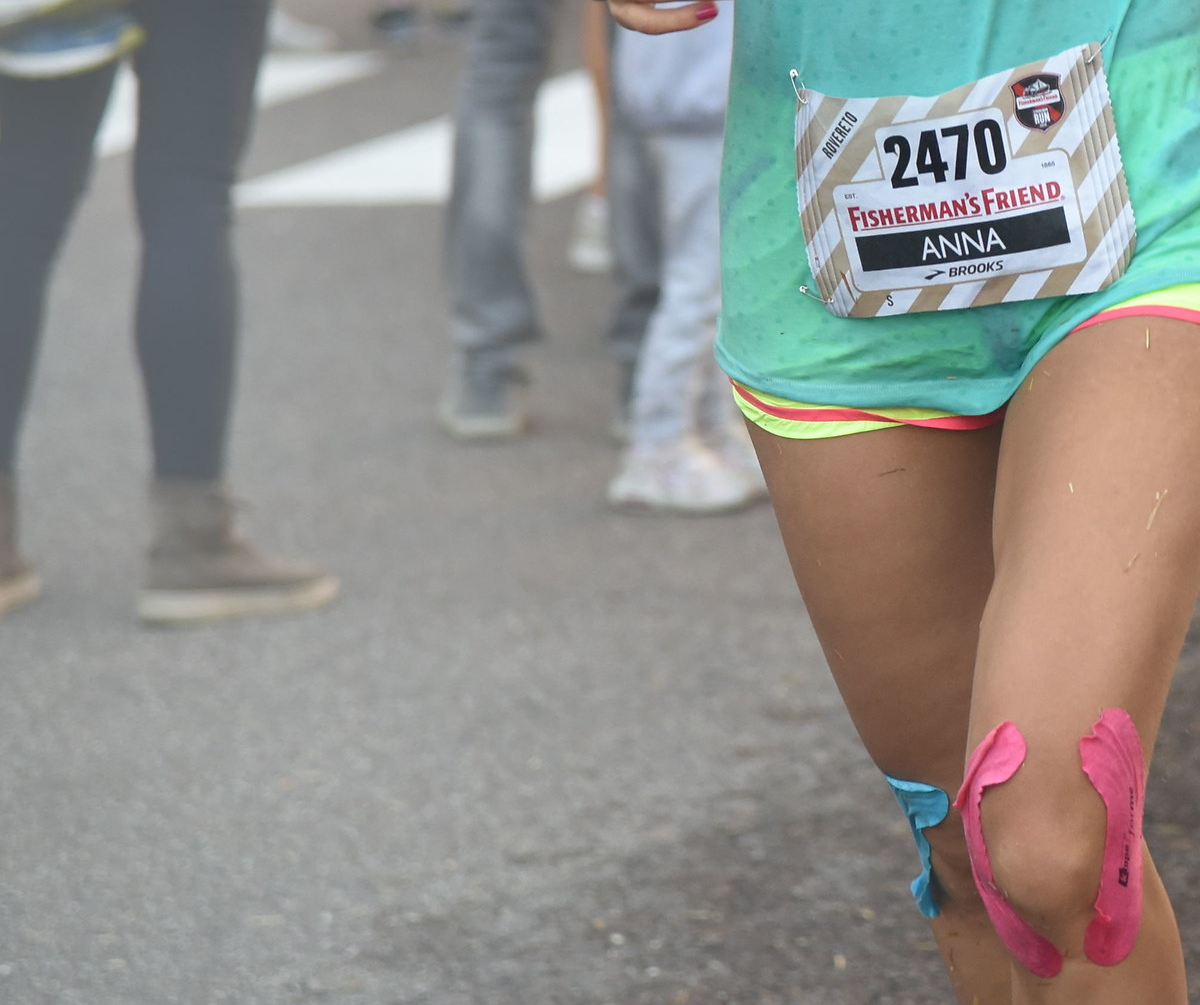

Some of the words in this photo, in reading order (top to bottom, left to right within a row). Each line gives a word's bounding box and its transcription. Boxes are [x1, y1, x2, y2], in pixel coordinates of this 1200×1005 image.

[822, 111, 858, 160] ROVERETO
[883, 119, 1007, 189] 2470
[847, 192, 981, 232] FISHERMAN'S
[981, 181, 1061, 216] FRIEND
[922, 227, 1007, 261] ANNA
[948, 260, 1004, 278] BROOKS
[886, 294, 895, 307] S
